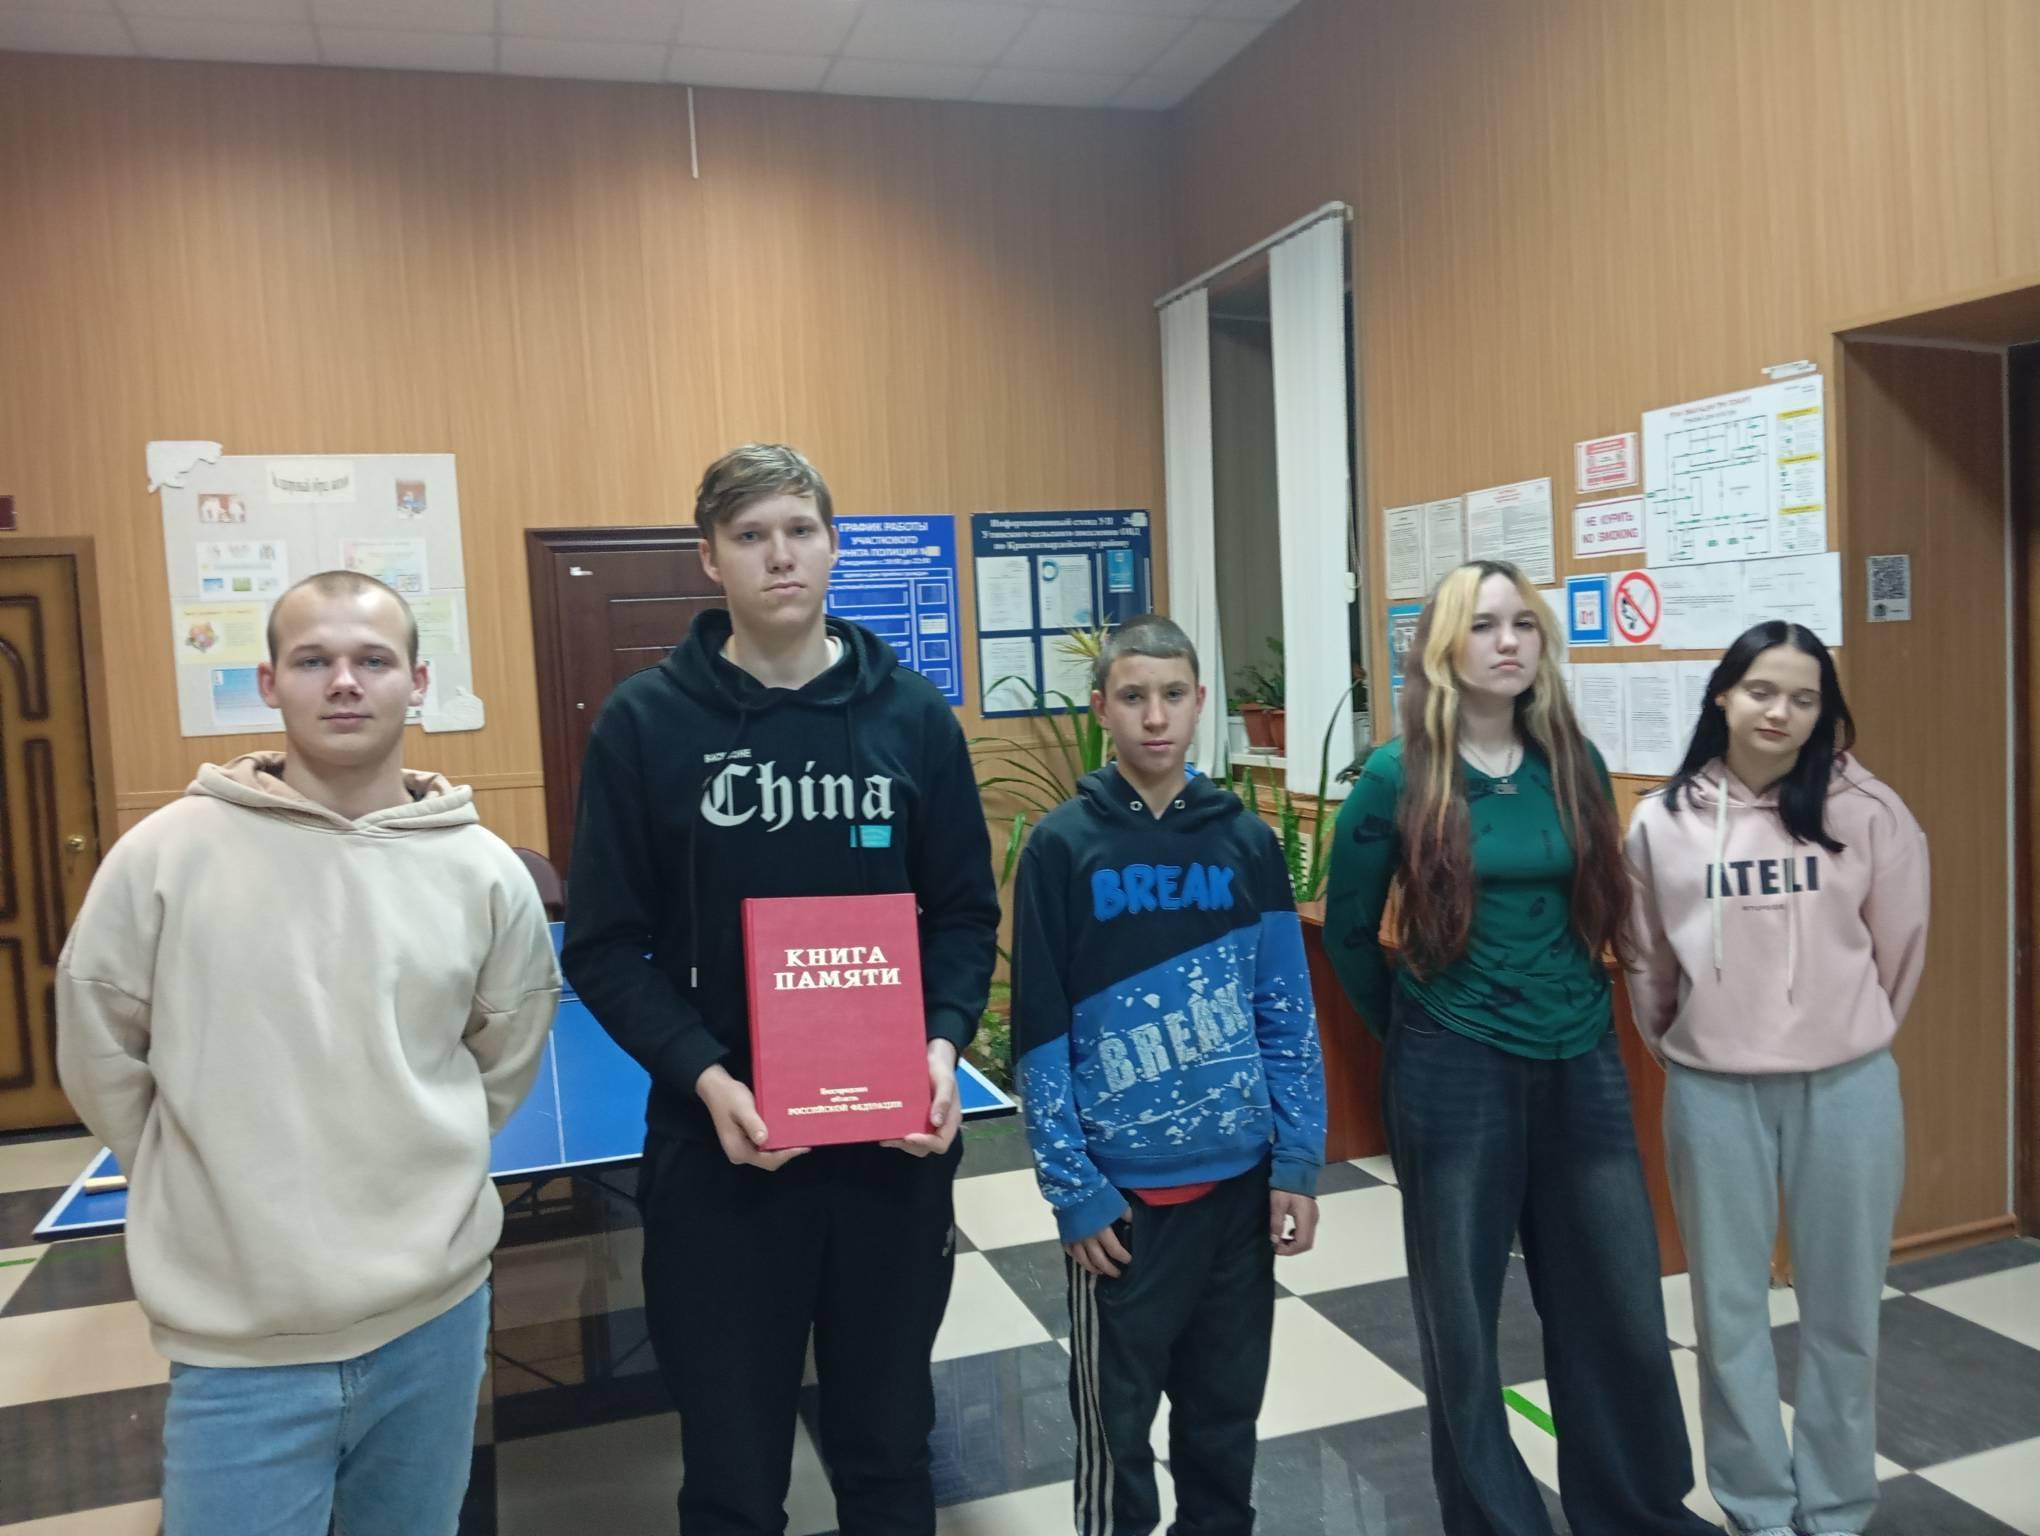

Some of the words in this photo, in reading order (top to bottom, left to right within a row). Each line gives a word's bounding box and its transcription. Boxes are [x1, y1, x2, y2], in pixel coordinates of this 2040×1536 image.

[700, 761, 895, 832] China
[1091, 862, 1235, 921] BREAK
[773, 968, 901, 990] ПАМЯТИ
[784, 946, 888, 967] КНИГА
[1099, 981, 1249, 1093] BREAK
